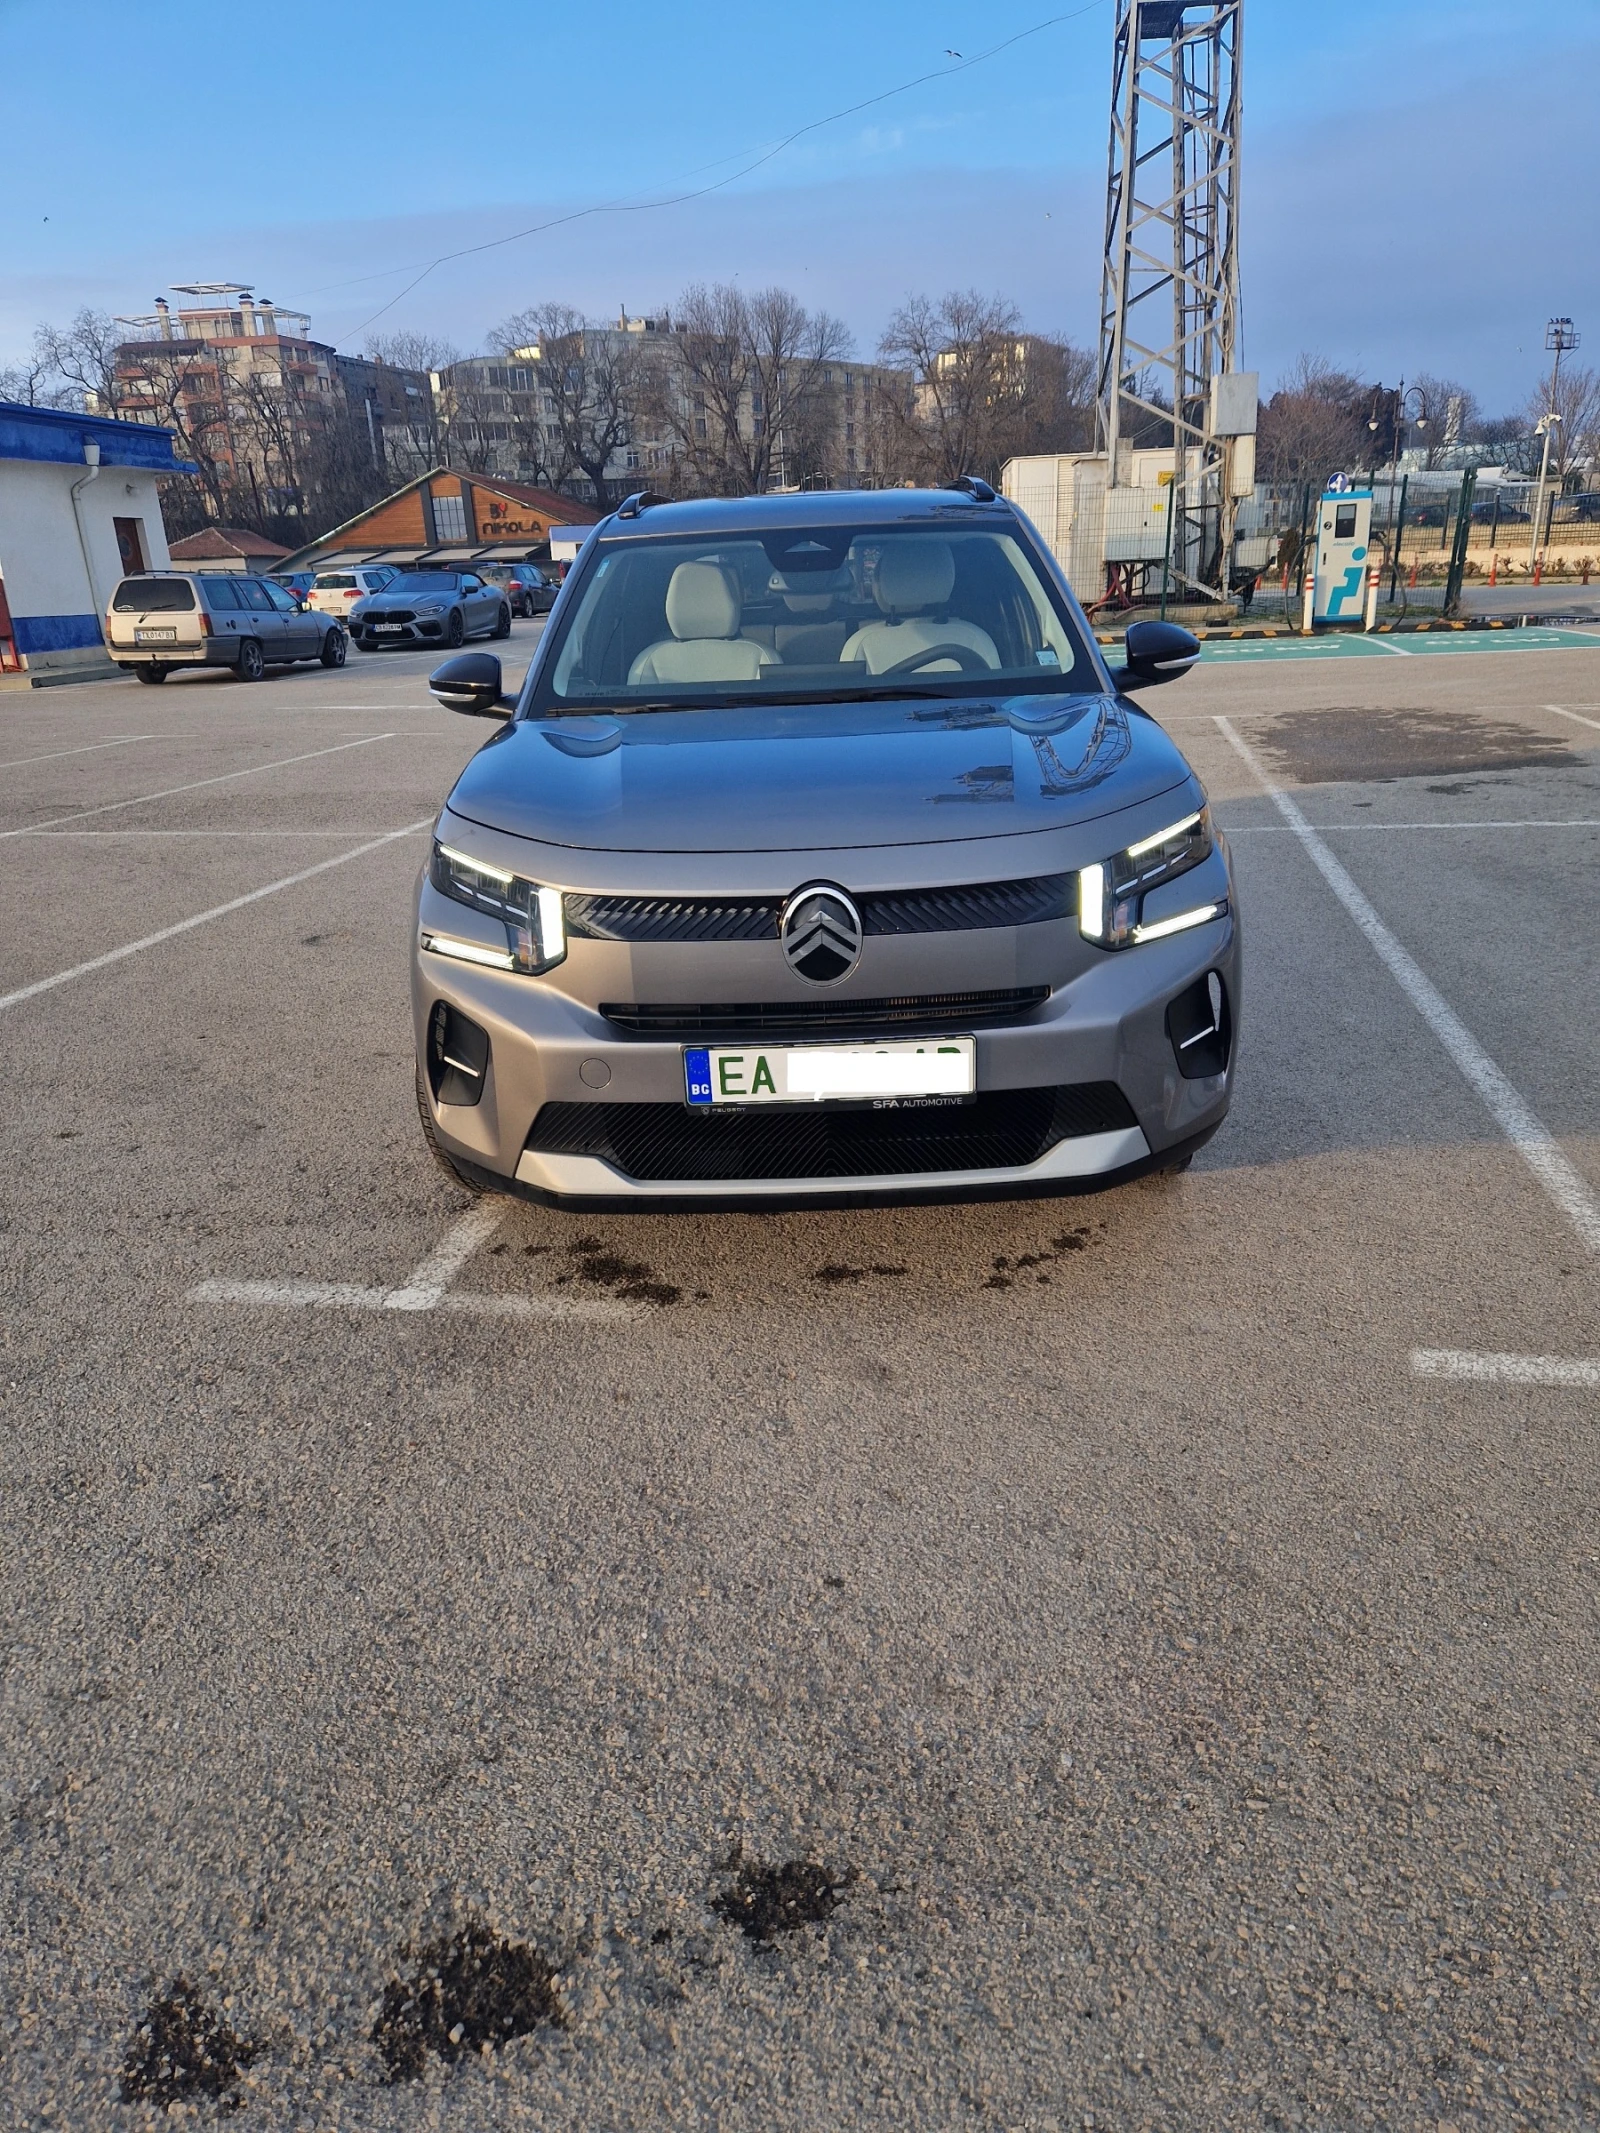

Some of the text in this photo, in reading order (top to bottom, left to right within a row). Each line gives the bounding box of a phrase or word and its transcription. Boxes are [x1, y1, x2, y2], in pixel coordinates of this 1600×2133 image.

[483, 521, 542, 534] NIKOLA
[718, 1055, 777, 1095] EA
[691, 1084, 710, 1095] BG
[872, 1097, 963, 1109] SFA AUTOMOTIVE
